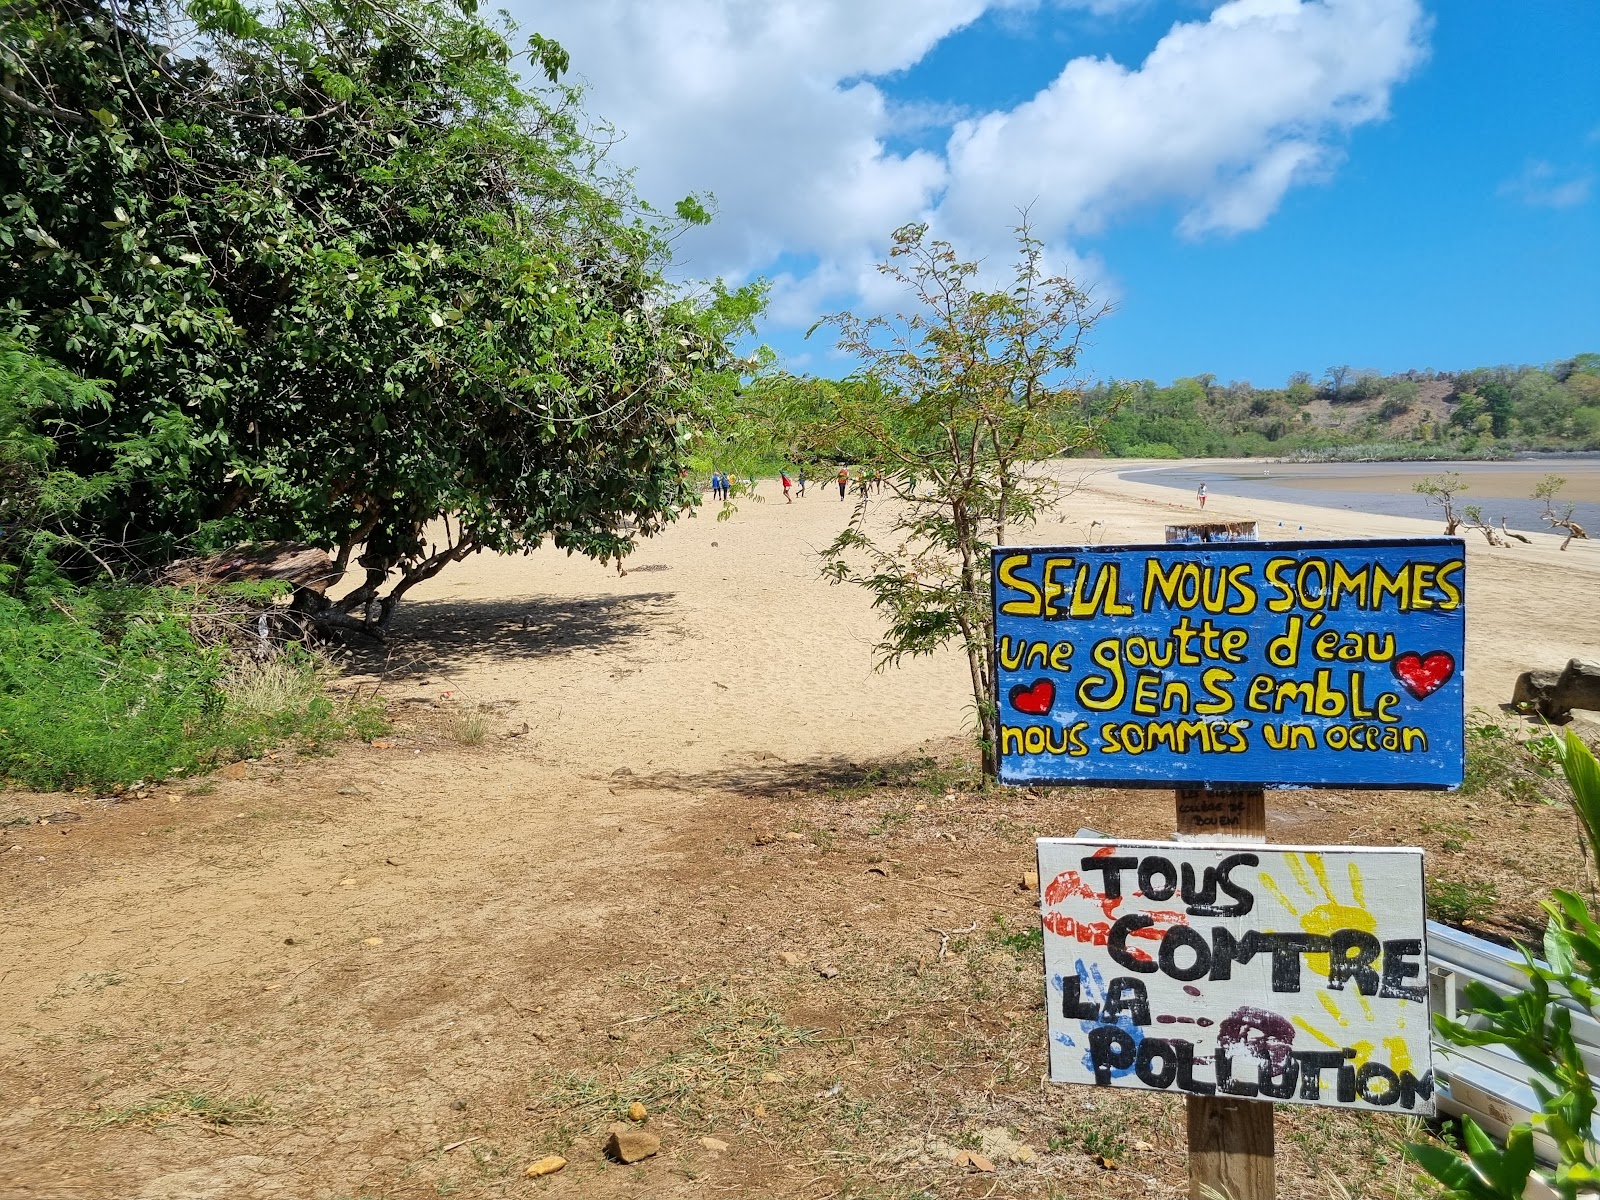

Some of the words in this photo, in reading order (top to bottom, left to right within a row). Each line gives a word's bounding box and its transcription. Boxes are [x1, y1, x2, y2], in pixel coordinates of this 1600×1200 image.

[997, 553, 1134, 621] SEUL
[1141, 557, 1258, 615] NOUS
[1263, 556, 1465, 613] SOMMES
[999, 633, 1074, 671] une
[1076, 615, 1248, 716] goutte
[1265, 611, 1397, 669] d'eau
[1000, 720, 1089, 757] nous
[1262, 723, 1317, 751] un
[1324, 724, 1429, 753] ocean
[1081, 853, 1260, 918] TOUS
[1062, 974, 1152, 1026] LA
[1088, 1024, 1435, 1110] POLLUTION
